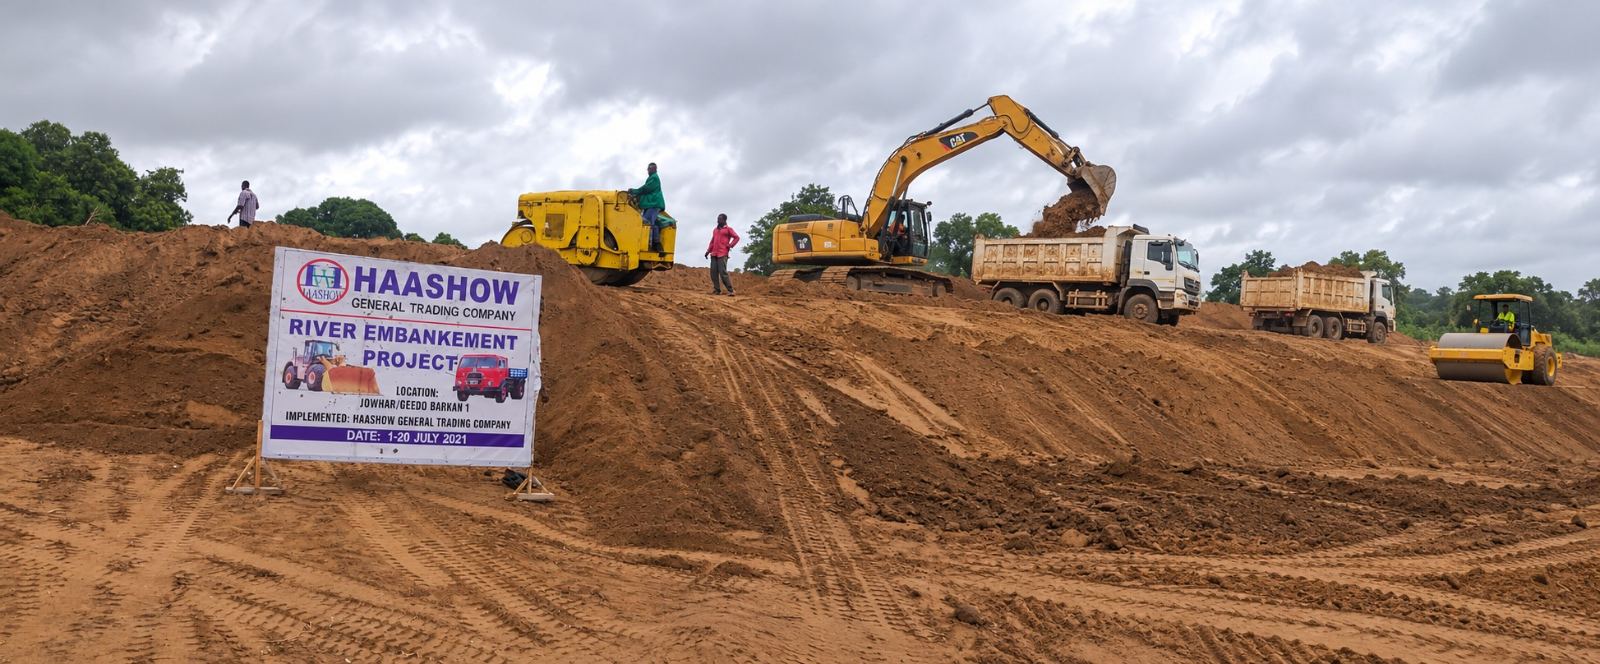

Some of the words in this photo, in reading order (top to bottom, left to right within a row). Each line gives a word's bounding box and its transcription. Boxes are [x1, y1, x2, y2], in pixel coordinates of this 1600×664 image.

[950, 134, 965, 148] CAT
[354, 266, 520, 305] HAASHOW
[352, 298, 406, 312] GENERAL
[410, 303, 460, 316] TRADING
[463, 308, 516, 321] COMPANY
[289, 318, 356, 340] RIVER
[364, 324, 518, 350] EMBANKEMENT
[363, 350, 458, 371] PROJECT
[396, 386, 438, 398] LOCATION:
[360, 398, 427, 411] JOWHAR/GEEDO
[430, 402, 463, 412] BARKAN
[466, 404, 470, 412] 1
[286, 412, 350, 423] IMPLEMENTED:
[353, 414, 396, 425] HAASHOW
[398, 416, 434, 426] GENERAL
[437, 418, 470, 428] TRADING
[474, 420, 511, 429] COMPANY
[346, 430, 380, 441] DATE:
[388, 432, 410, 442] 1-20
[414, 433, 440, 444] JULY
[442, 434, 466, 444] 2021
